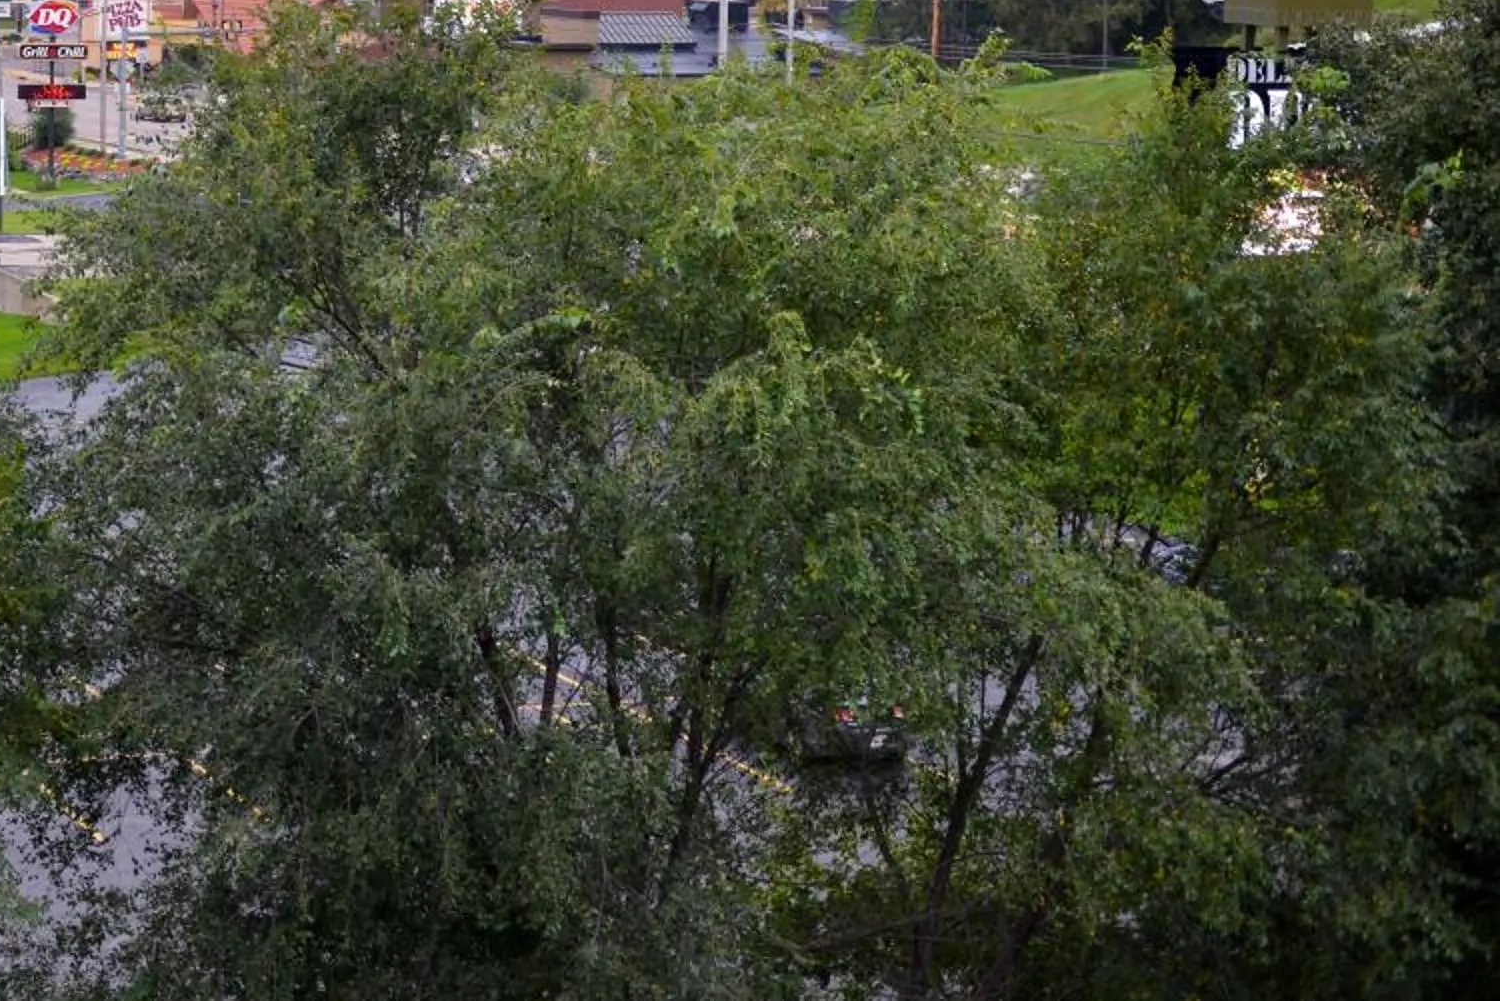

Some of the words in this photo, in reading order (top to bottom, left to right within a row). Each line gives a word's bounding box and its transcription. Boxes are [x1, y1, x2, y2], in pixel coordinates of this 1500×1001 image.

[37, 7, 72, 28] DQ
[22, 46, 48, 58] Grill
[57, 46, 85, 58] Chill
